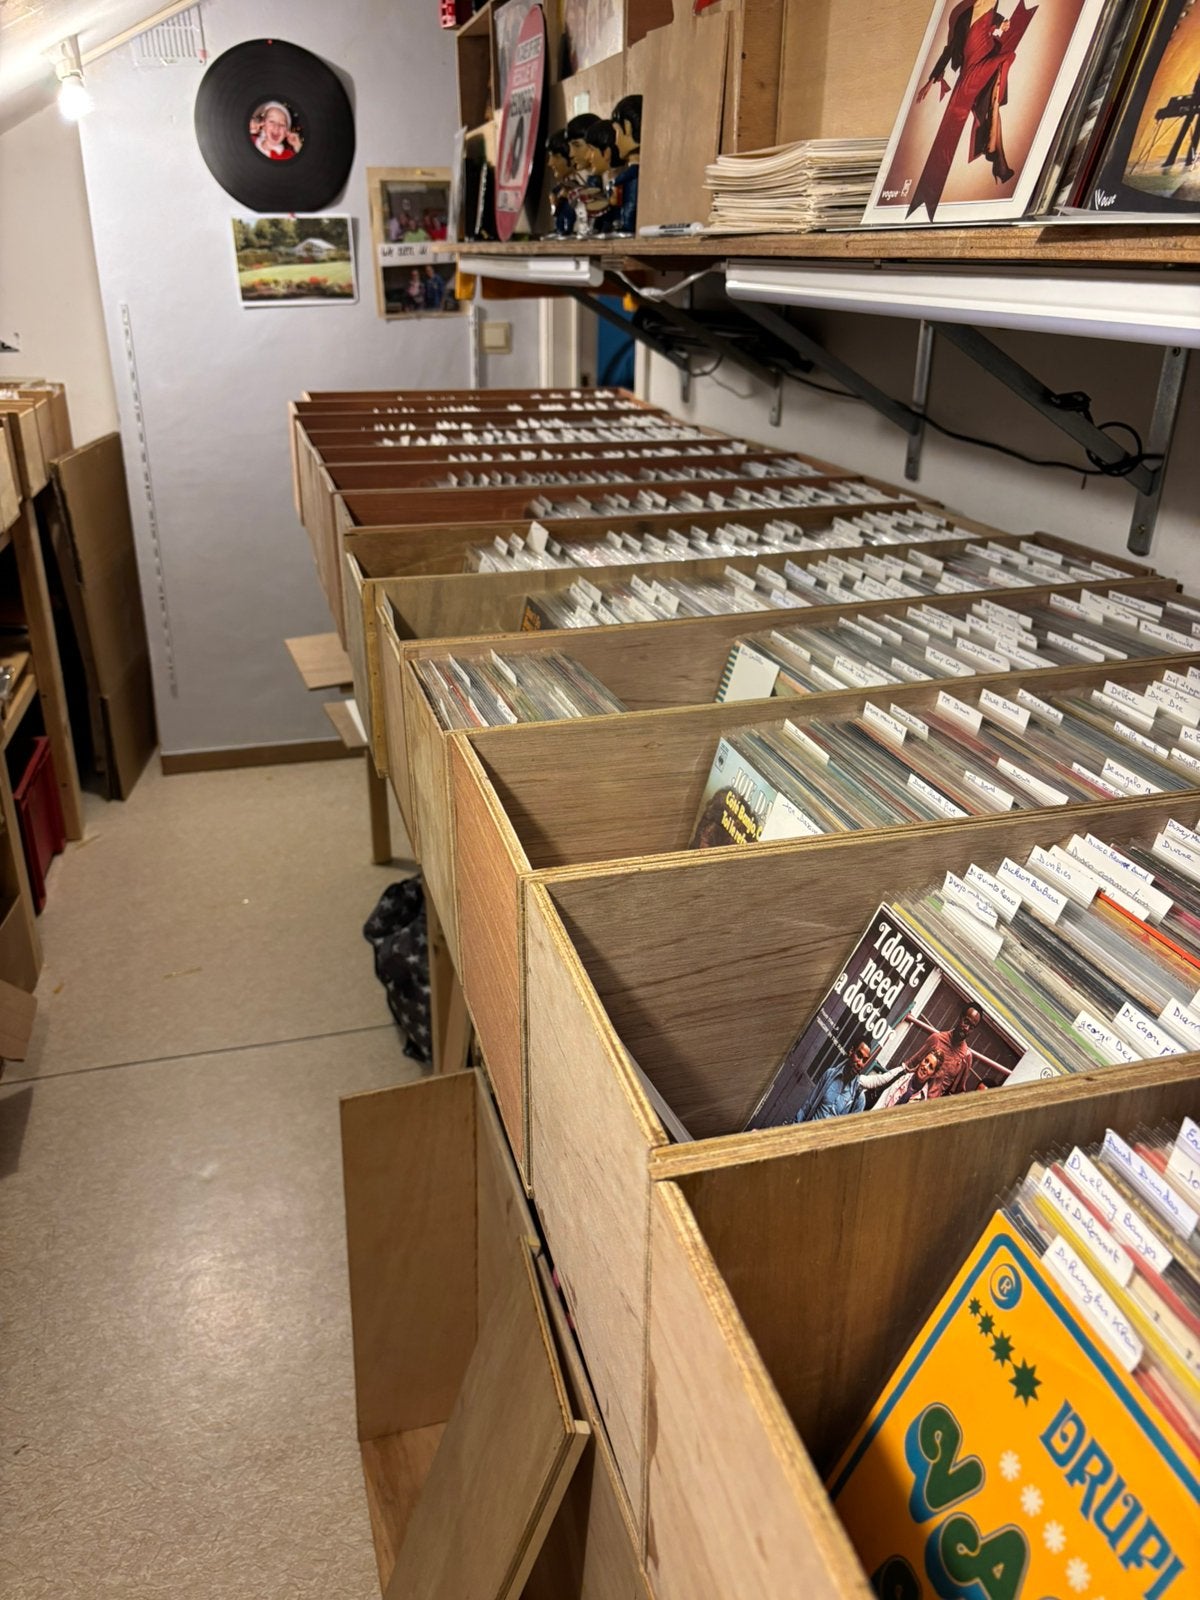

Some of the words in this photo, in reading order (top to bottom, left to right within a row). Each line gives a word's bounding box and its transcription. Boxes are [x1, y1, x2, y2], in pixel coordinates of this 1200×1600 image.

[858, 957, 906, 1010] need
[880, 932, 927, 988] don't
[833, 971, 849, 996] a
[842, 980, 898, 1048] doctor
[1039, 1399, 1186, 1600] DRUPI
